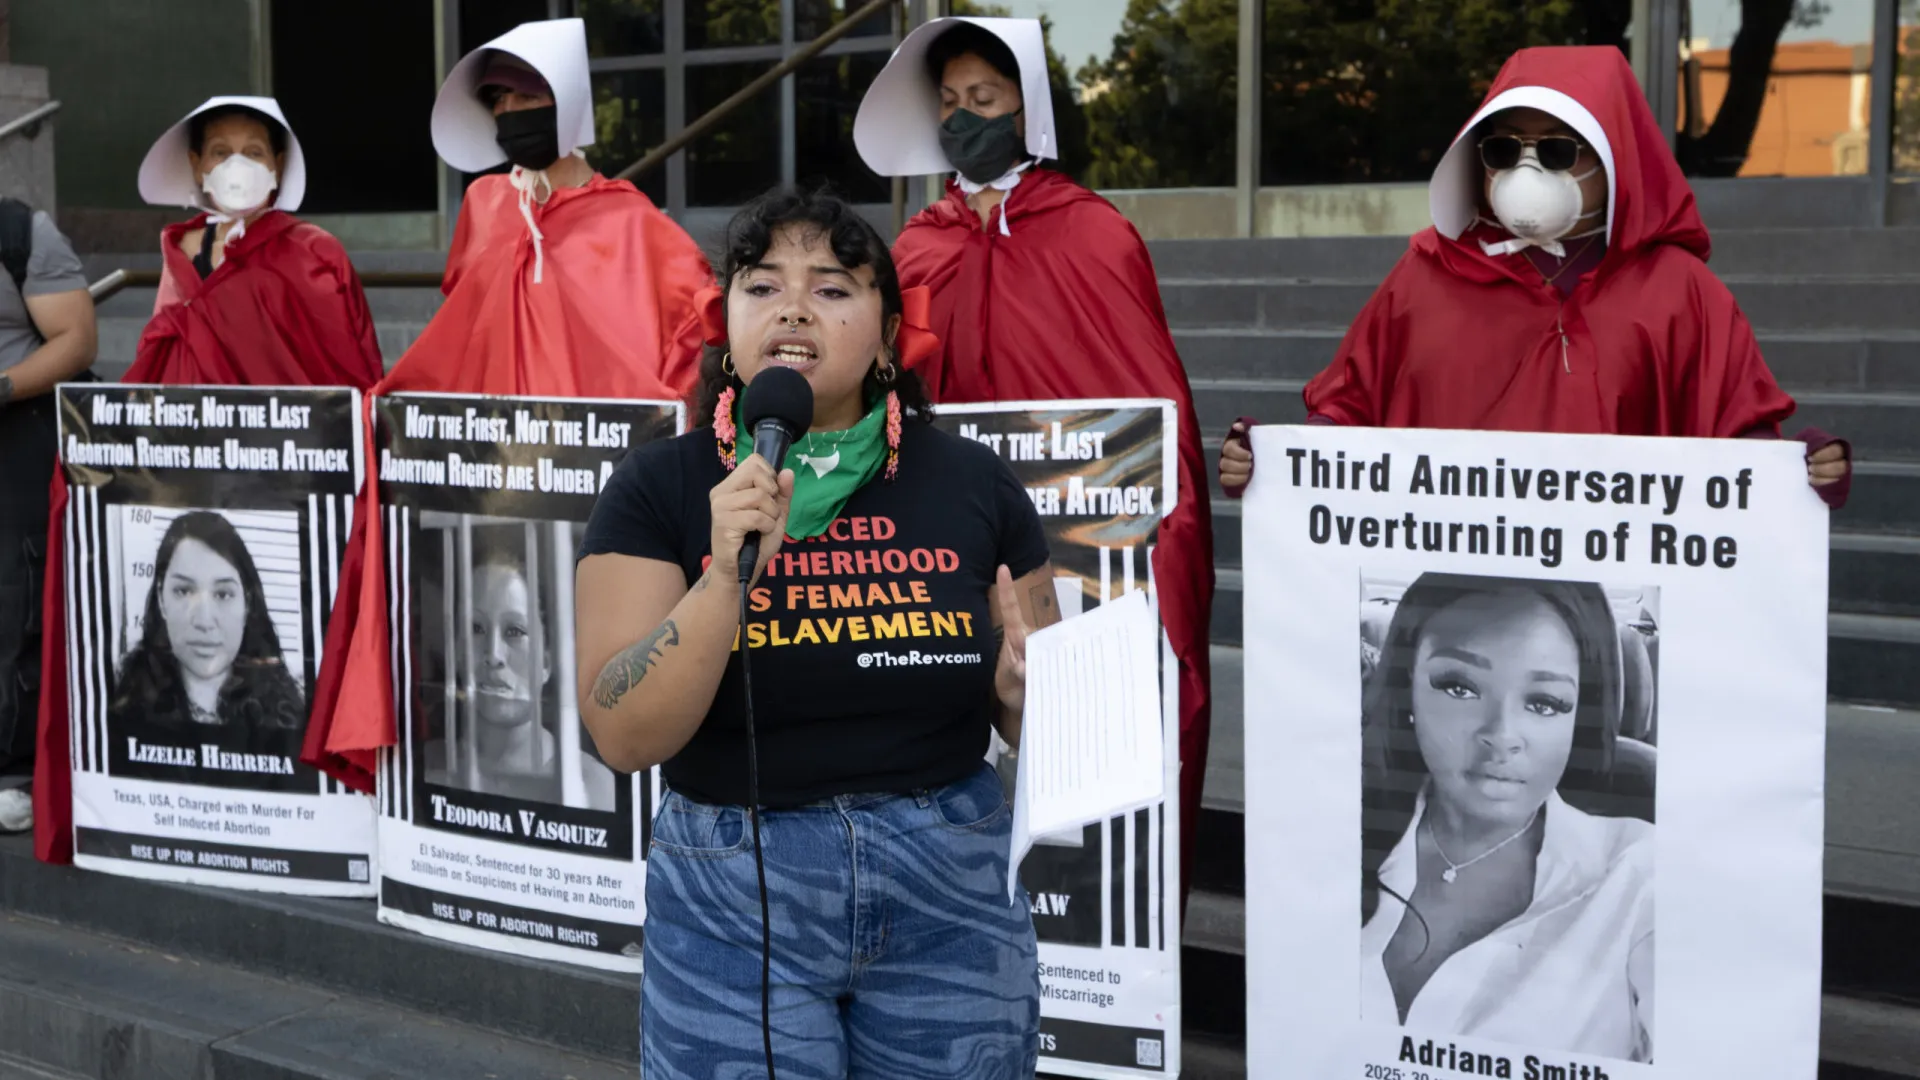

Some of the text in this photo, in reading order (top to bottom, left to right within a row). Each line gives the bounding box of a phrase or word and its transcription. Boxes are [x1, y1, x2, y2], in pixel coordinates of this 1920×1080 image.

[92, 394, 311, 430] NOT THE FIRST, NOT THE LAST
[405, 404, 632, 449] NOT THE FIRST, NOT THE LAST
[67, 433, 349, 472] ABORTION RIGHTS ARE UNDER ATTACK
[1007, 432, 1045, 461] THE
[1051, 421, 1106, 460] LAST
[380, 448, 445, 485] ABORTION
[448, 452, 502, 489] RIGHTS
[506, 463, 534, 490] ARE
[537, 457, 594, 494] UNDER
[1286, 447, 1753, 516] Third Anniversary of
[1065, 476, 1155, 516] ATTACK
[783, 516, 896, 544] CED
[1308, 504, 1738, 569] Overturning of Roe
[702, 548, 960, 577] THERHOOD
[750, 580, 932, 612] S FEMALE
[731, 611, 973, 652] SLAVEMENT
[857, 651, 982, 668] @TheRevcoms
[127, 736, 295, 776] LIZELLE HERRERA
[113, 789, 315, 821] Texas, USA, Charged with Murder For
[153, 812, 271, 837] Self Induced Abortion
[430, 794, 608, 848] TEODORA VASQUEZ
[130, 844, 290, 874] RISE UP FOR ABORTION RIGHTS
[419, 843, 623, 890] El Salvador, Sentenced for 30 years After
[411, 860, 636, 911] Stillbirth on Suspicions of Having an Abortion
[1030, 892, 1071, 916] AW
[432, 902, 599, 948] RISE UP FOR ABORTION RIGHTS
[1038, 962, 1121, 985] Sentenced to
[1039, 984, 1115, 1008] Miscarriage
[1398, 1035, 1610, 1080] Adriana Smith
